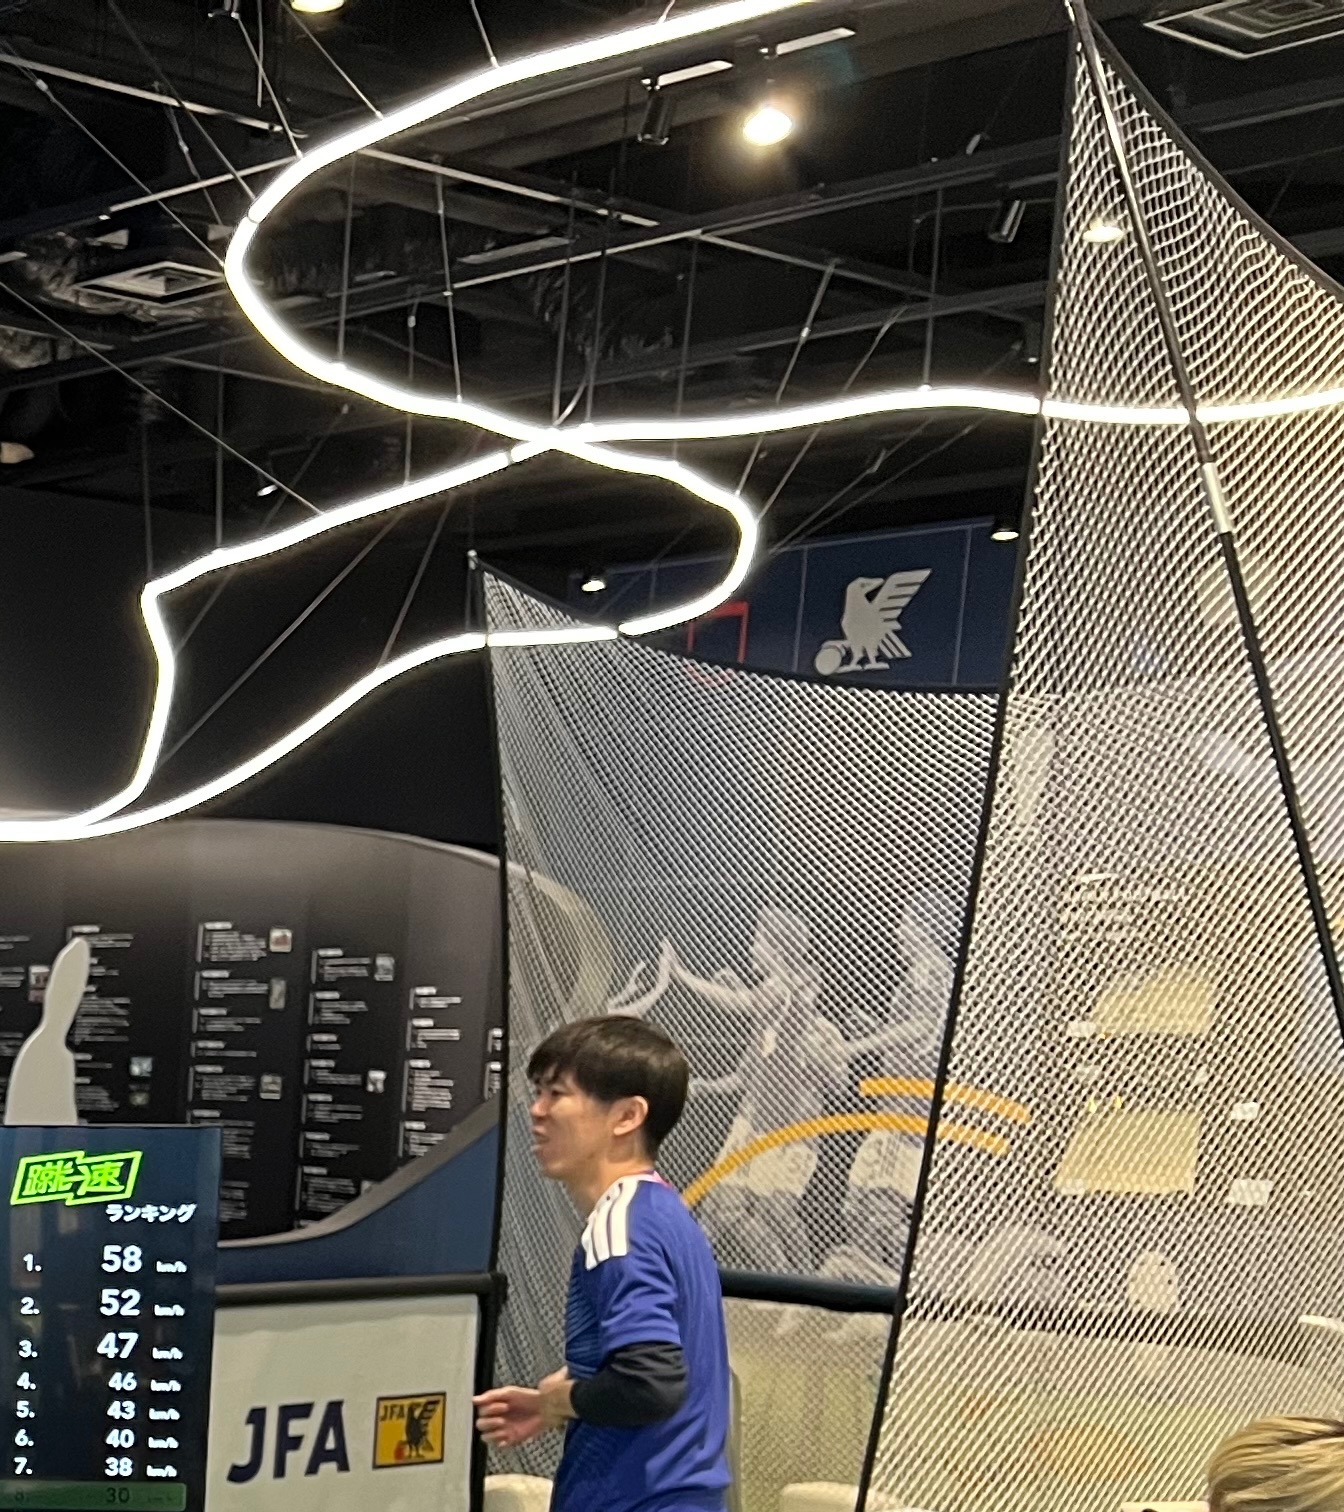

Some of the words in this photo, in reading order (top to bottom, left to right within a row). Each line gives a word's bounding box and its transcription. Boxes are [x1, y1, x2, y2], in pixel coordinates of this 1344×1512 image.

[106, 1203, 198, 1223] ランキング
[23, 1253, 42, 1272] 1.
[101, 1244, 142, 1273] 58
[20, 1296, 40, 1315] 2.
[100, 1288, 141, 1317] 52
[18, 1340, 38, 1358] 3.
[97, 1332, 139, 1359] 47
[16, 1372, 37, 1390] 4.
[108, 1372, 137, 1391] 46
[16, 1401, 35, 1418] 5.
[106, 1400, 136, 1420] 43
[380, 1404, 405, 1422] JFA
[14, 1429, 34, 1447] 6.
[105, 1429, 135, 1449] 40
[227, 1399, 350, 1483] JFA
[14, 1457, 33, 1475] 7.
[104, 1457, 133, 1477] 38
[106, 1486, 130, 1503] 30
